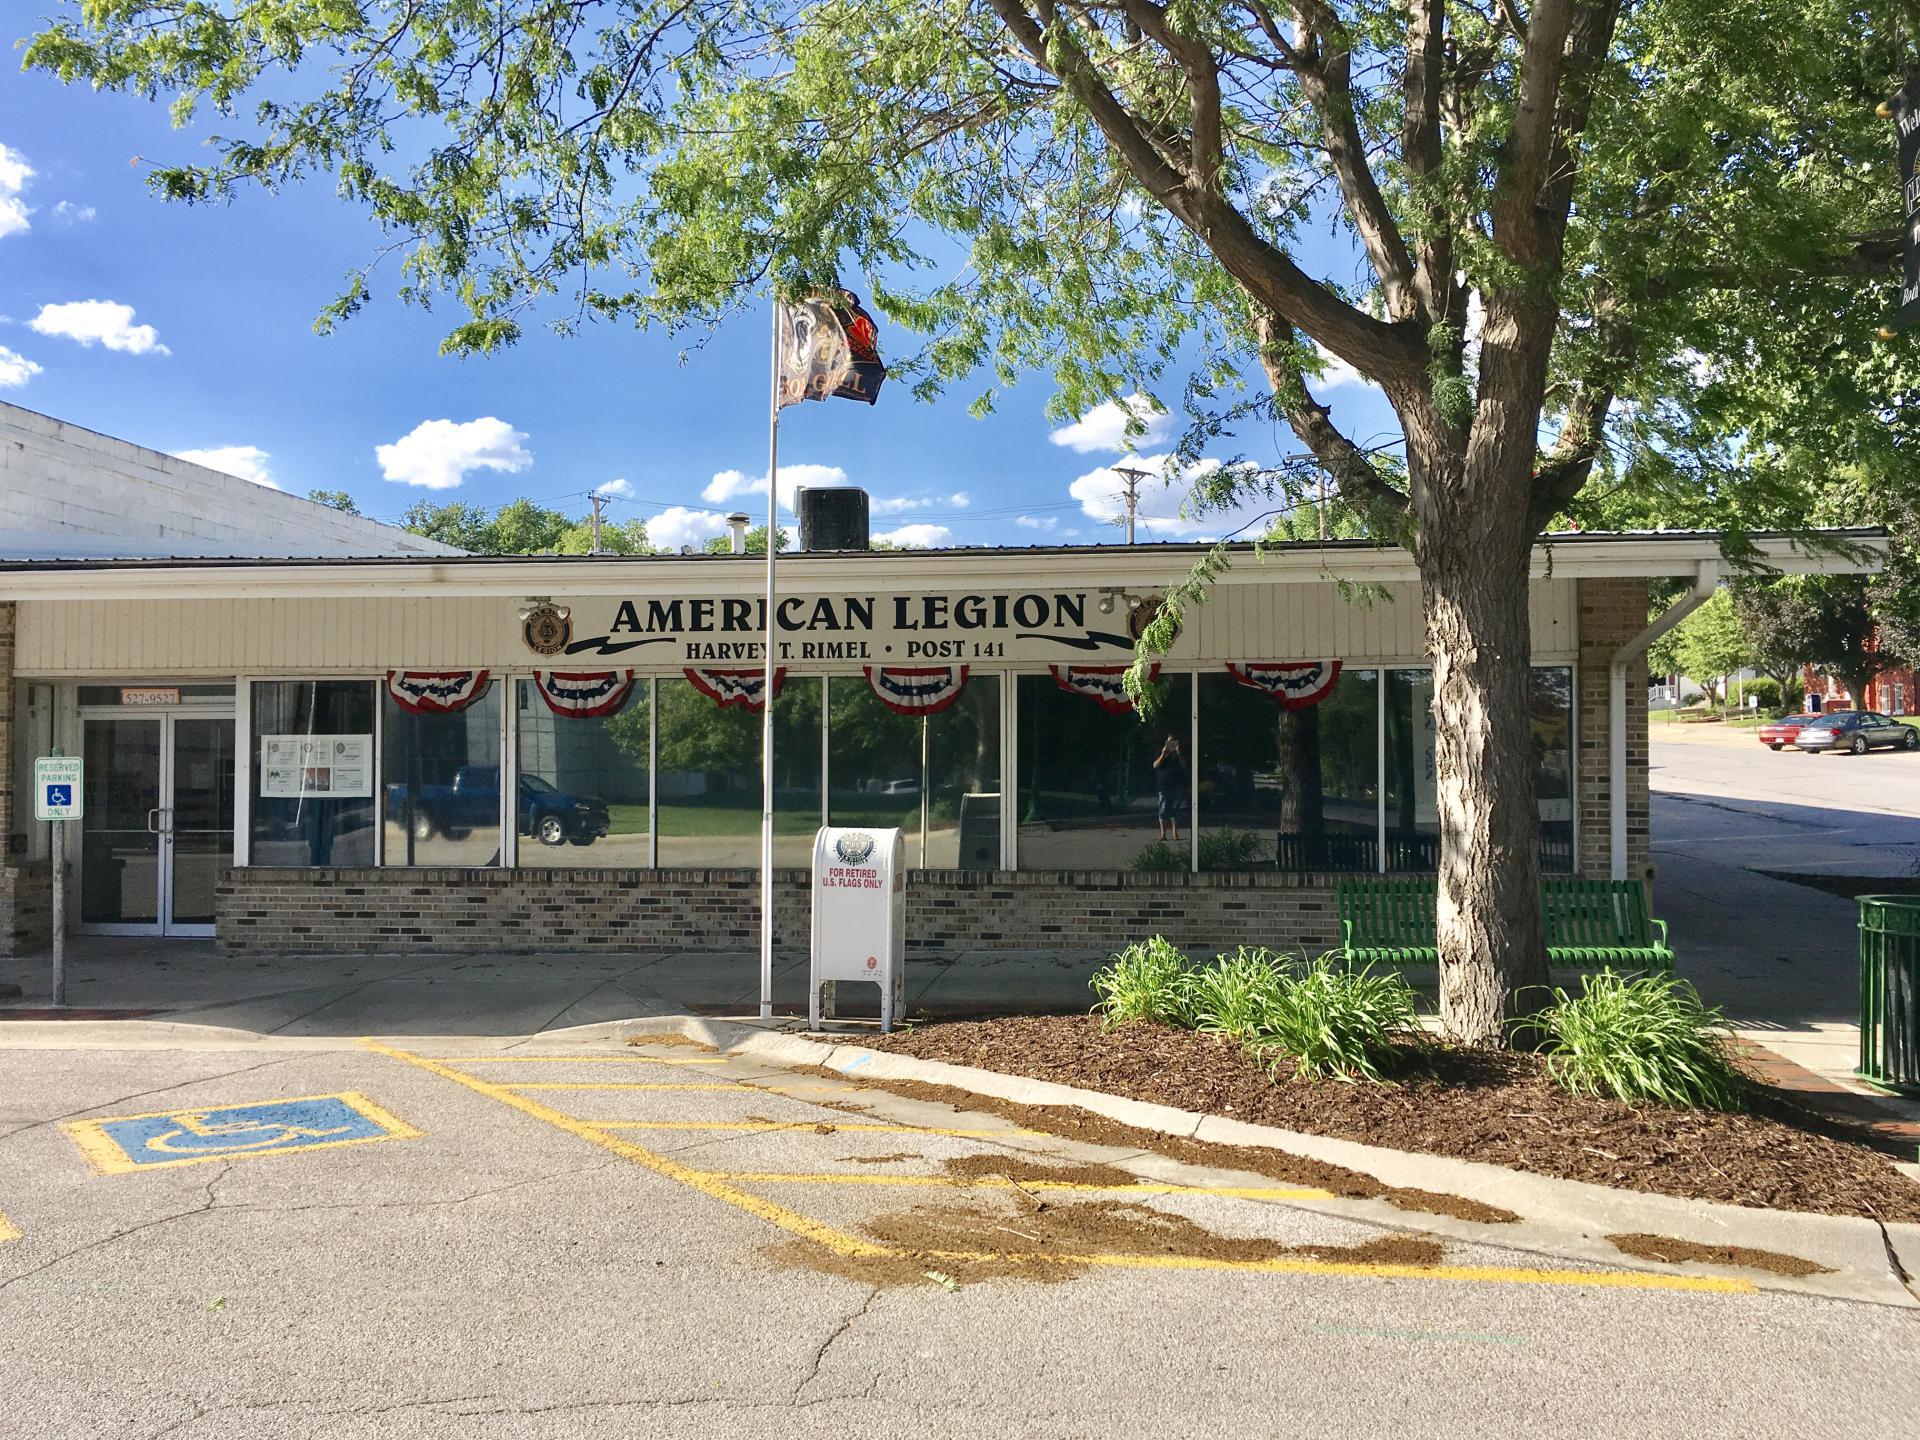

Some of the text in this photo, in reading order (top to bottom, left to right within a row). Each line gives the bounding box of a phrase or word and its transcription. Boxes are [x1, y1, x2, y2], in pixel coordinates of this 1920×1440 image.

[1900, 108, 1920, 138] Wel
[610, 593, 1087, 632] AMERICAN LEGION
[532, 643, 563, 655] LEGION
[779, 642, 796, 659] T.
[801, 641, 871, 659] RIMEL
[907, 640, 966, 658] POST
[973, 642, 1004, 657] 141
[126, 693, 175, 705] 527-9527
[38, 763, 80, 772] RESERVED
[41, 774, 77, 782] PARKING
[47, 807, 71, 816] ONLY
[829, 868, 877, 878] FOR RETIRED
[822, 878, 883, 888] U.S. FLAGS ONLY
